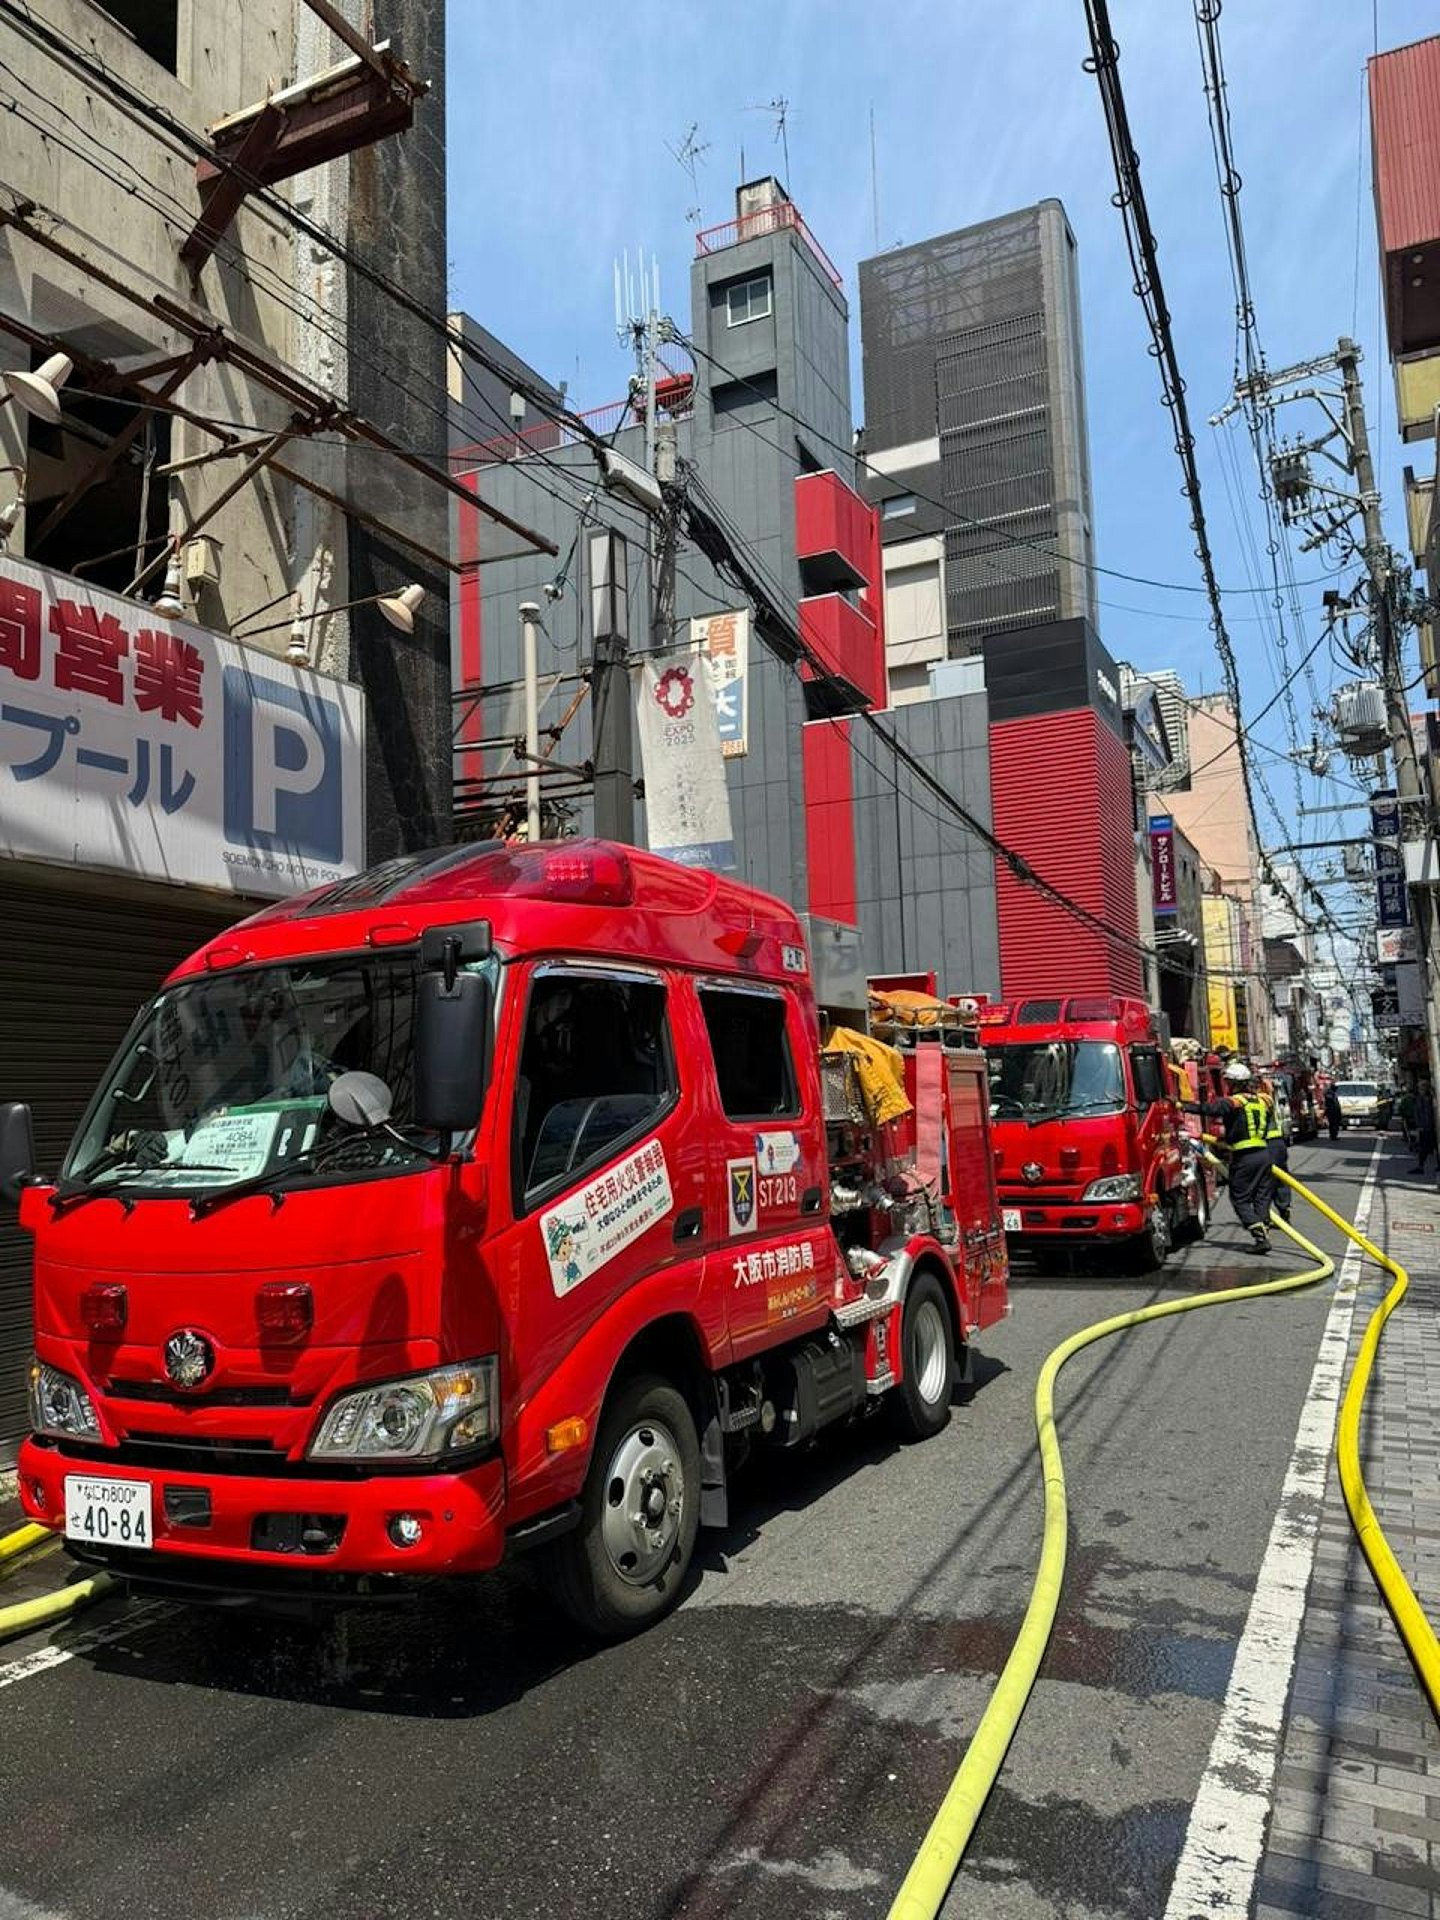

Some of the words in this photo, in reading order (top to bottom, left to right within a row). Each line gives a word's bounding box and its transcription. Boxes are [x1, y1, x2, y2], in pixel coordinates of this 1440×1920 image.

[708, 615, 737, 657] 質
[664, 723, 695, 738] EXPO
[666, 734, 696, 747] 2025
[1, 703, 197, 816] プール
[252, 695, 326, 834] P
[286, 862, 319, 879] MOTOR
[321, 869, 342, 882] POO
[1157, 836, 1172, 902] サンロードビル
[732, 1242, 814, 1289] 大阪市消防局
[84, 1505, 146, 1543] 40-84
